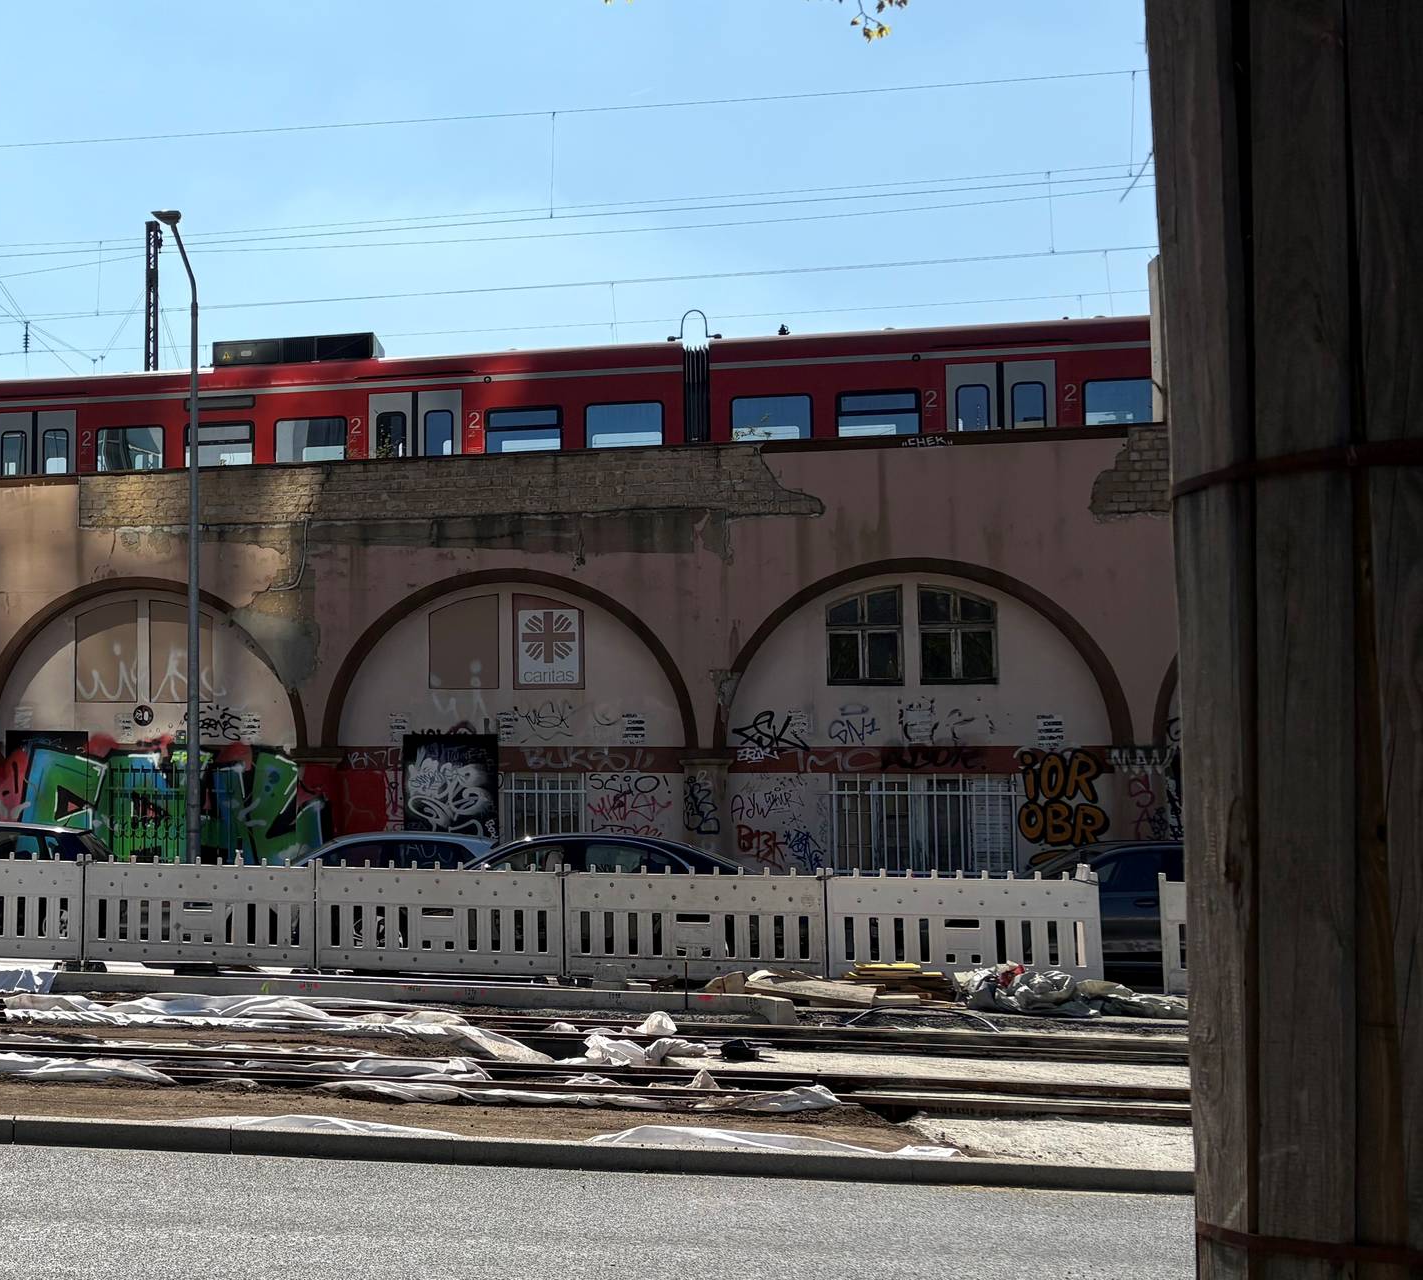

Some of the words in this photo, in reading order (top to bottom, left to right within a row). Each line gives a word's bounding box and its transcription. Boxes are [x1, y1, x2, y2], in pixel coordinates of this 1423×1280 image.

[924, 390, 938, 408] 2
[1064, 383, 1077, 401] 2
[350, 417, 362, 434] 2
[468, 412, 480, 429] 2
[81, 430, 92, 447] 2
[523, 669, 575, 683] caritas
